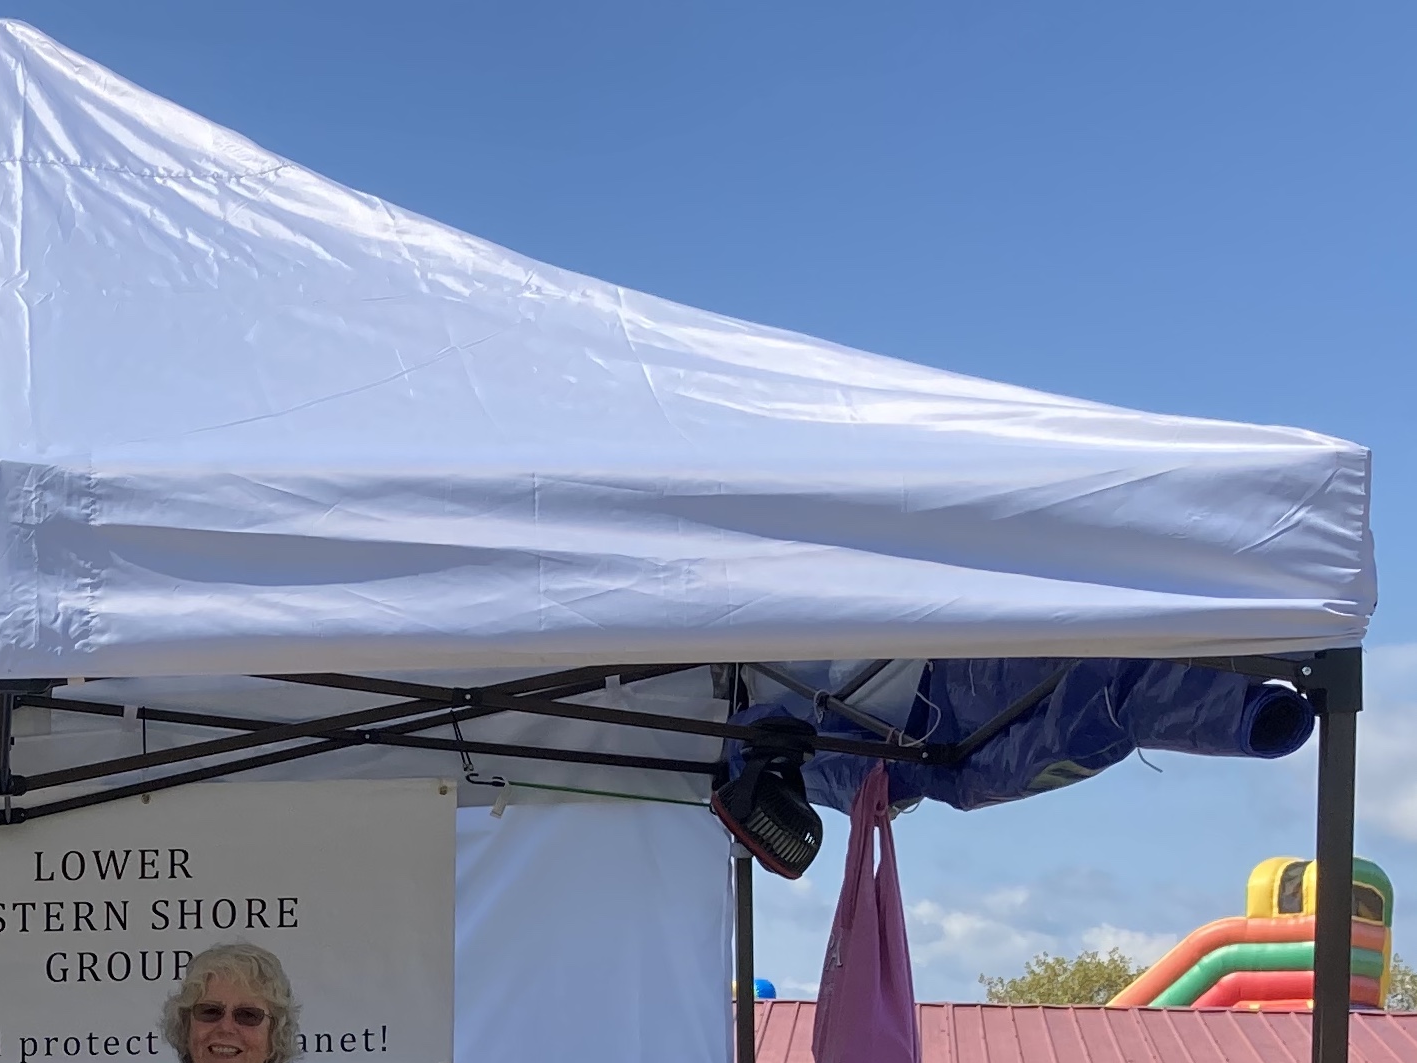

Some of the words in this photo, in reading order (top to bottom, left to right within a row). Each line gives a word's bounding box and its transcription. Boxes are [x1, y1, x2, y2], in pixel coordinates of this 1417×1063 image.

[34, 848, 193, 881] LOWER
[151, 897, 299, 930] SHORE
[46, 950, 193, 983] GROUP
[19, 1031, 159, 1063] protect
[297, 1025, 388, 1052] anet!
